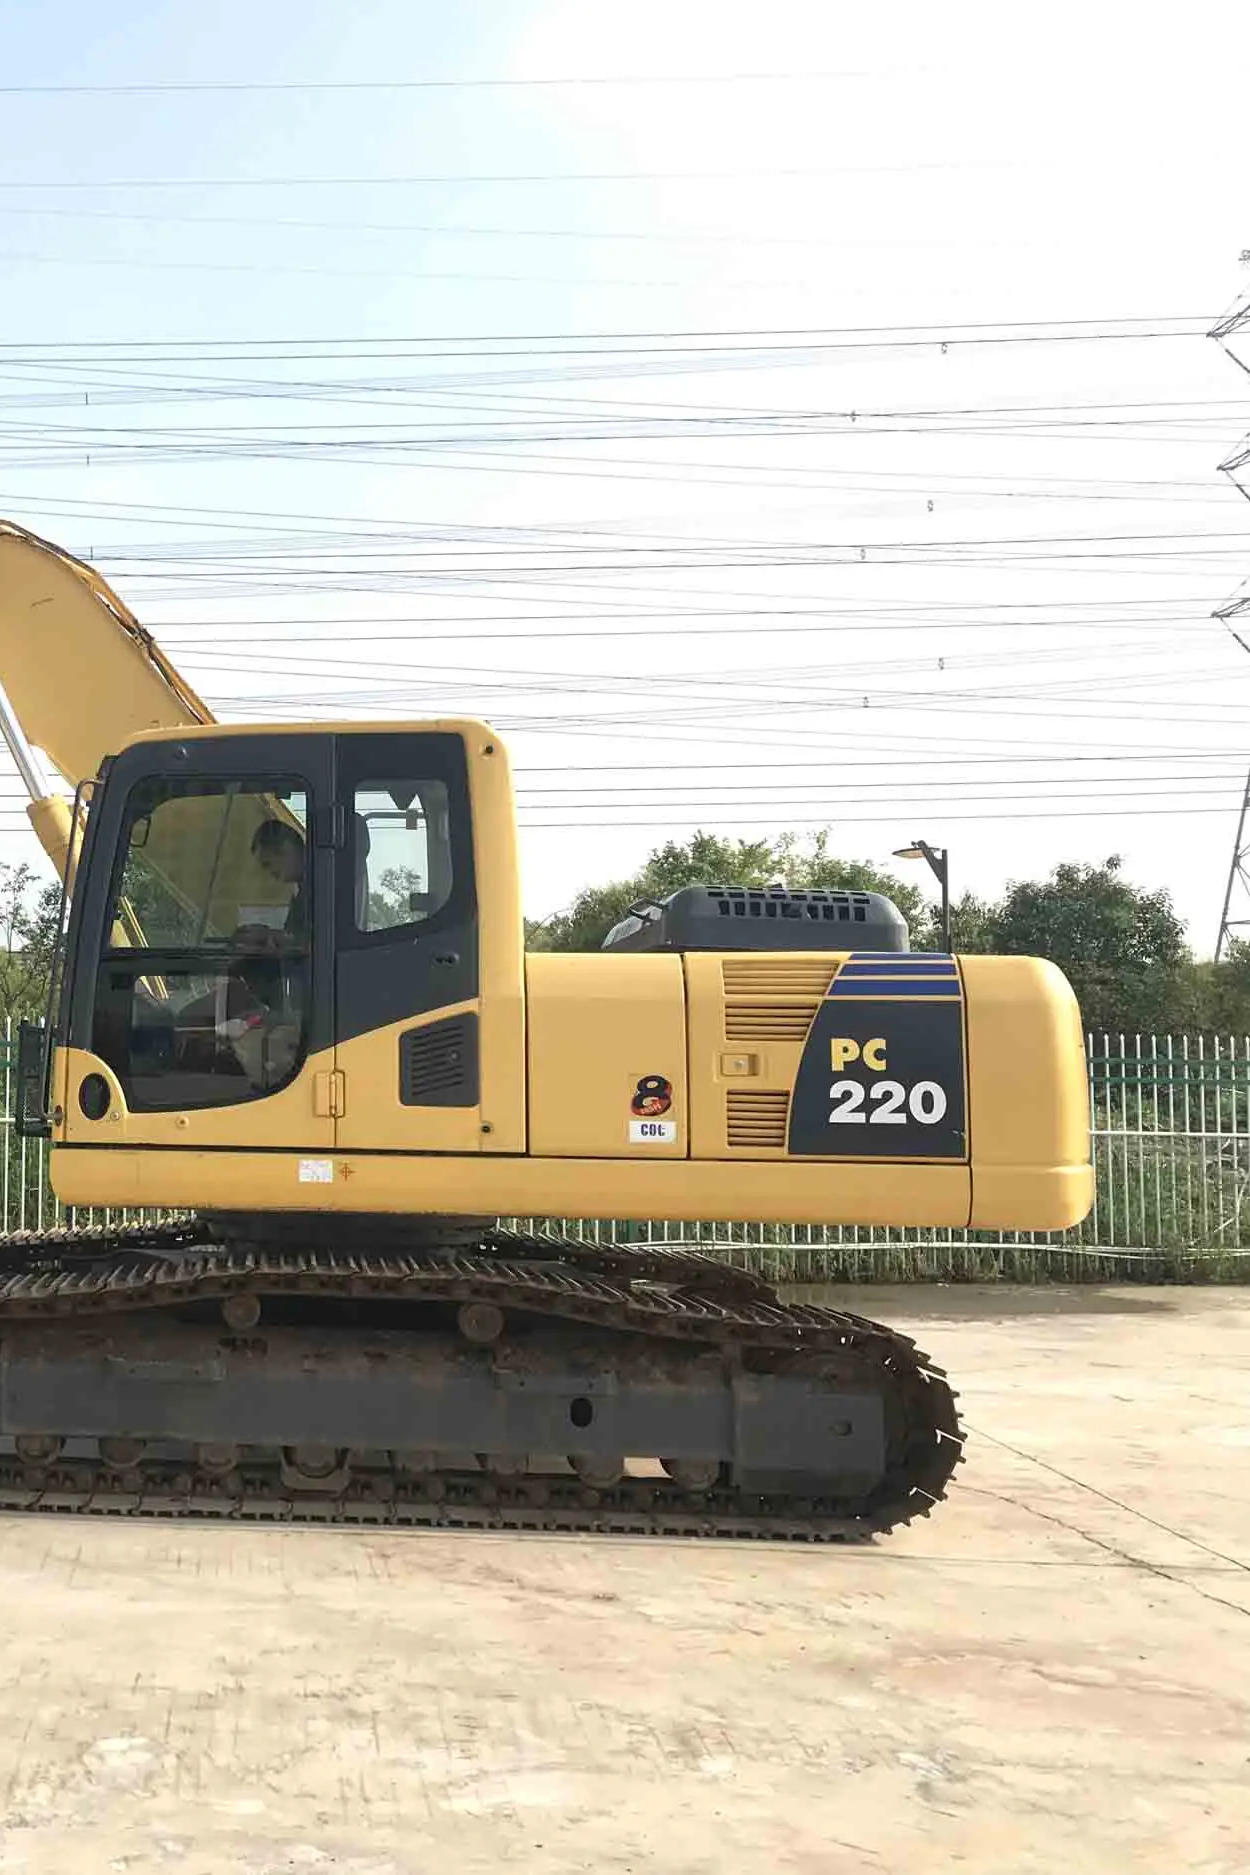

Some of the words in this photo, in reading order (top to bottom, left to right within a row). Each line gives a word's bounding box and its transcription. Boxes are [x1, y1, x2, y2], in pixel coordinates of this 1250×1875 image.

[830, 1038, 887, 1072] PC
[631, 1075, 672, 1117] 8
[829, 1080, 947, 1124] 220
